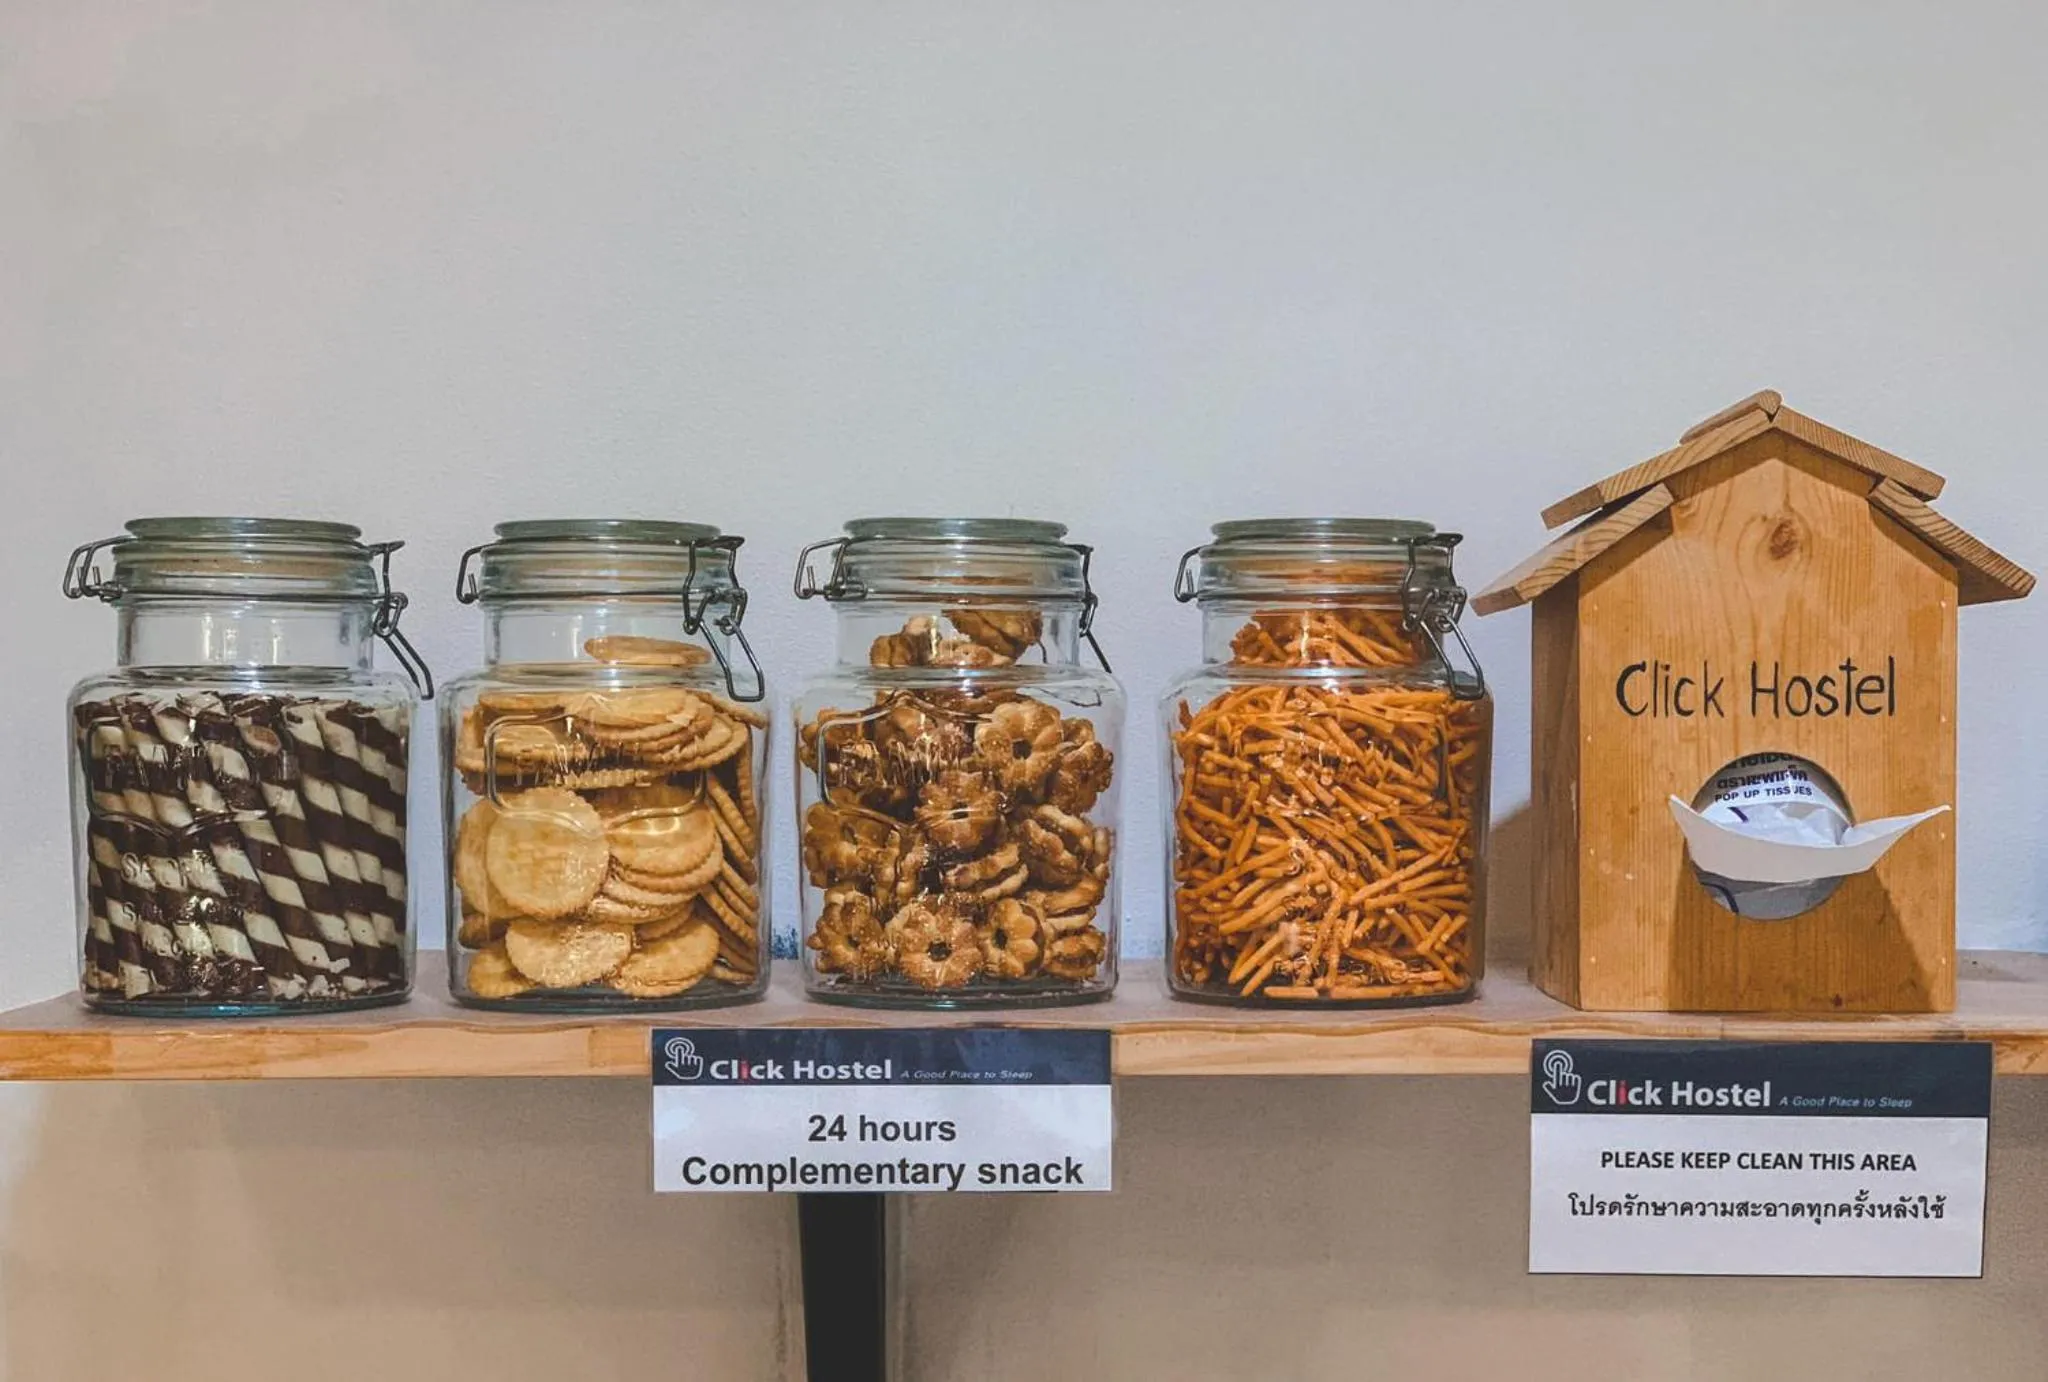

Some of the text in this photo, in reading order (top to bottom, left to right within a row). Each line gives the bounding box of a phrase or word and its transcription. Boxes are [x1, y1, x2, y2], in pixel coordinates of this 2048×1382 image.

[1616, 655, 1896, 719] Click Hostel
[1714, 792, 1739, 802] POP
[1744, 790, 1760, 799] UP
[710, 1059, 892, 1080] Click Hostel
[900, 1070, 1033, 1080] A Good Place to Sleep
[1587, 1080, 1771, 1107] Click Hostel
[1779, 1096, 1913, 1109] A Good Place to Sleep
[807, 1114, 957, 1142] 24 hours
[1601, 1151, 1917, 1171] PLEASE KEEP CLEAN THIS AREA
[682, 1157, 1084, 1192] Complementary snack
[1568, 1189, 1946, 1225] โปรดรักษาความสะอาดทุกครั้งหลังใช้
